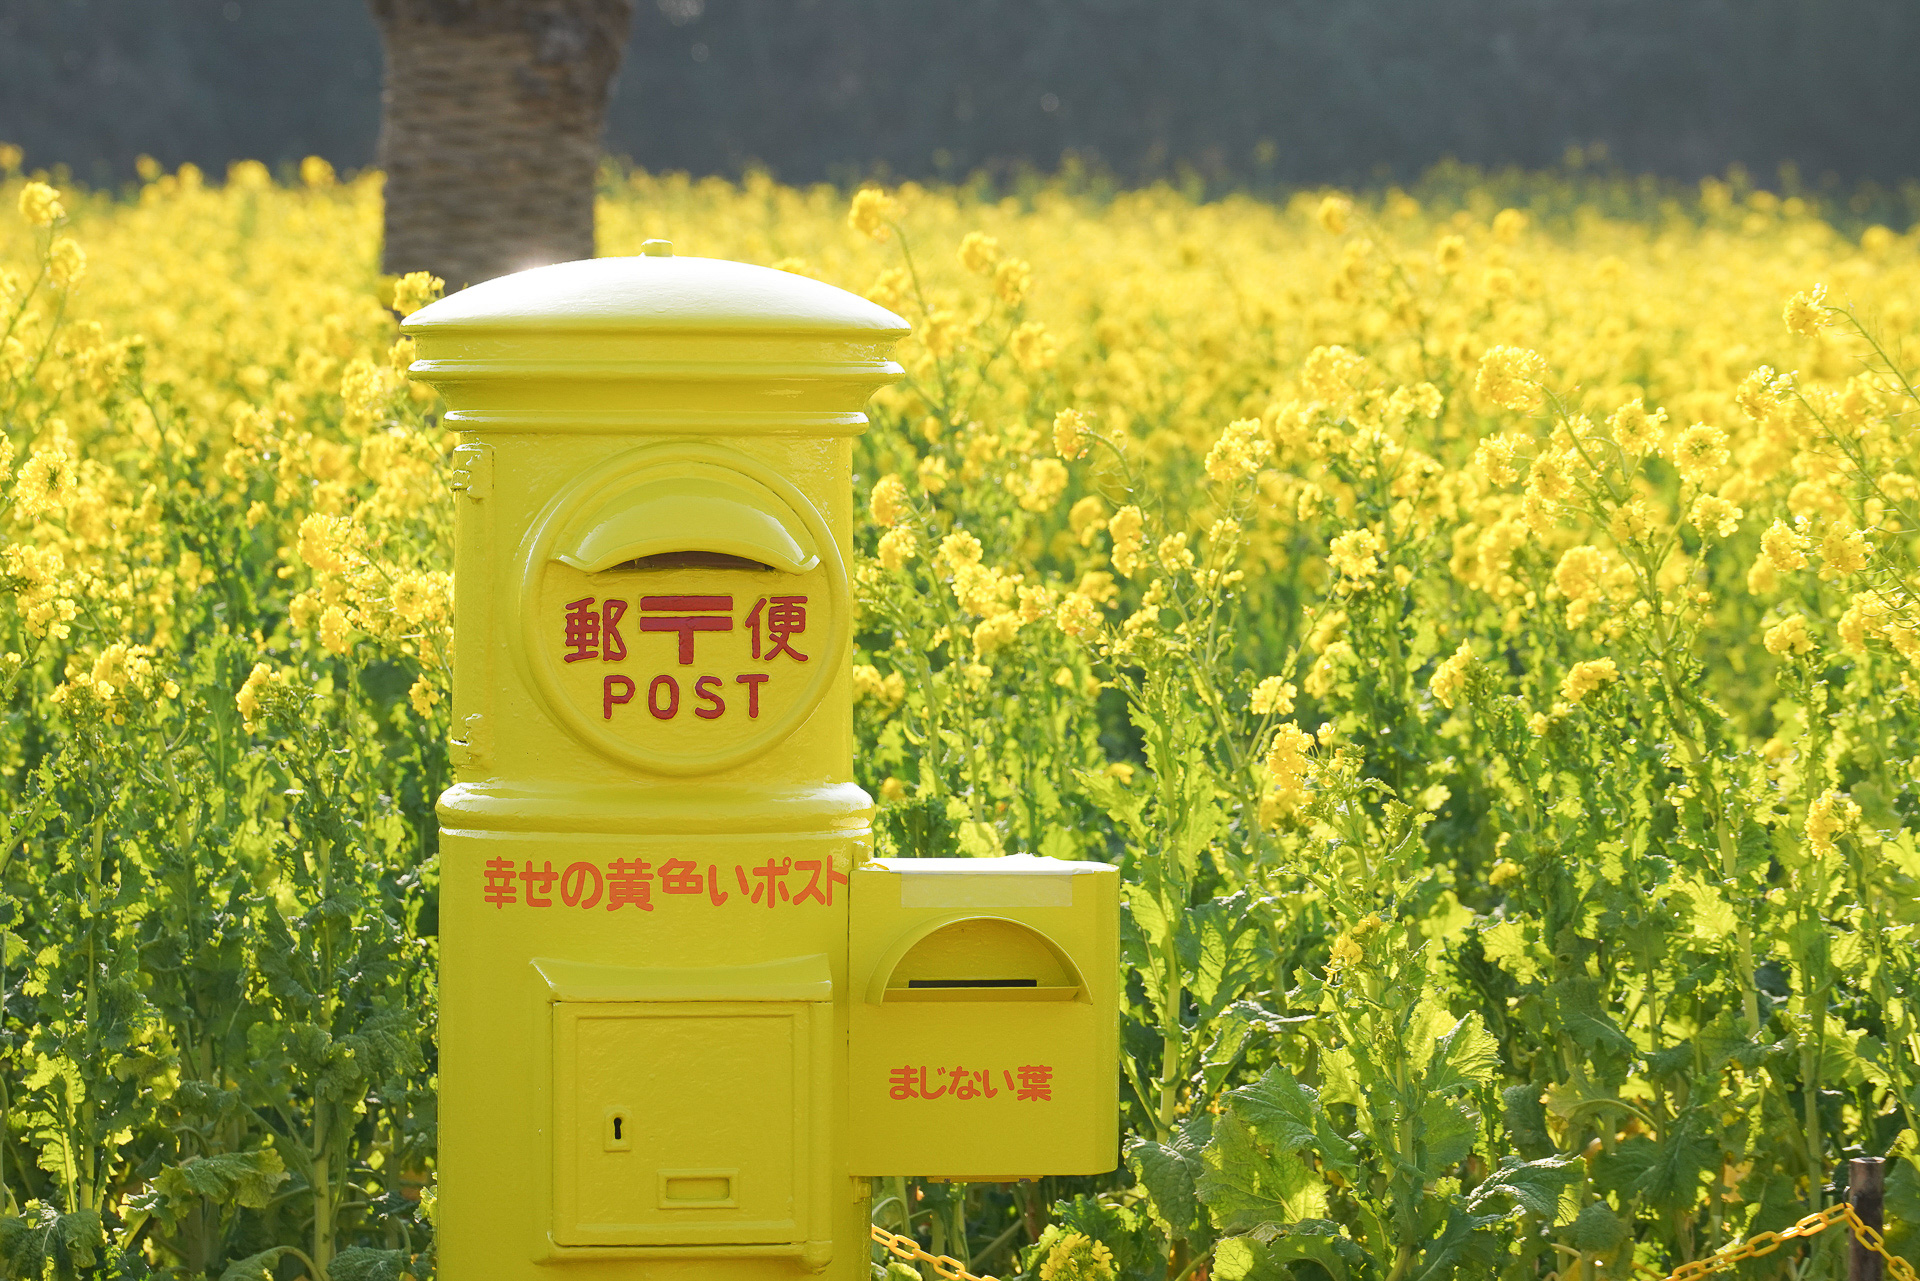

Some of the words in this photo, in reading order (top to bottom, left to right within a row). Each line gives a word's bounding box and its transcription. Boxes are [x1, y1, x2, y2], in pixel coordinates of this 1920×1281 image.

[603, 674, 769, 720] POST
[484, 855, 847, 911] 幸せの黄色いポスト
[889, 1065, 1053, 1101] まじない葉
